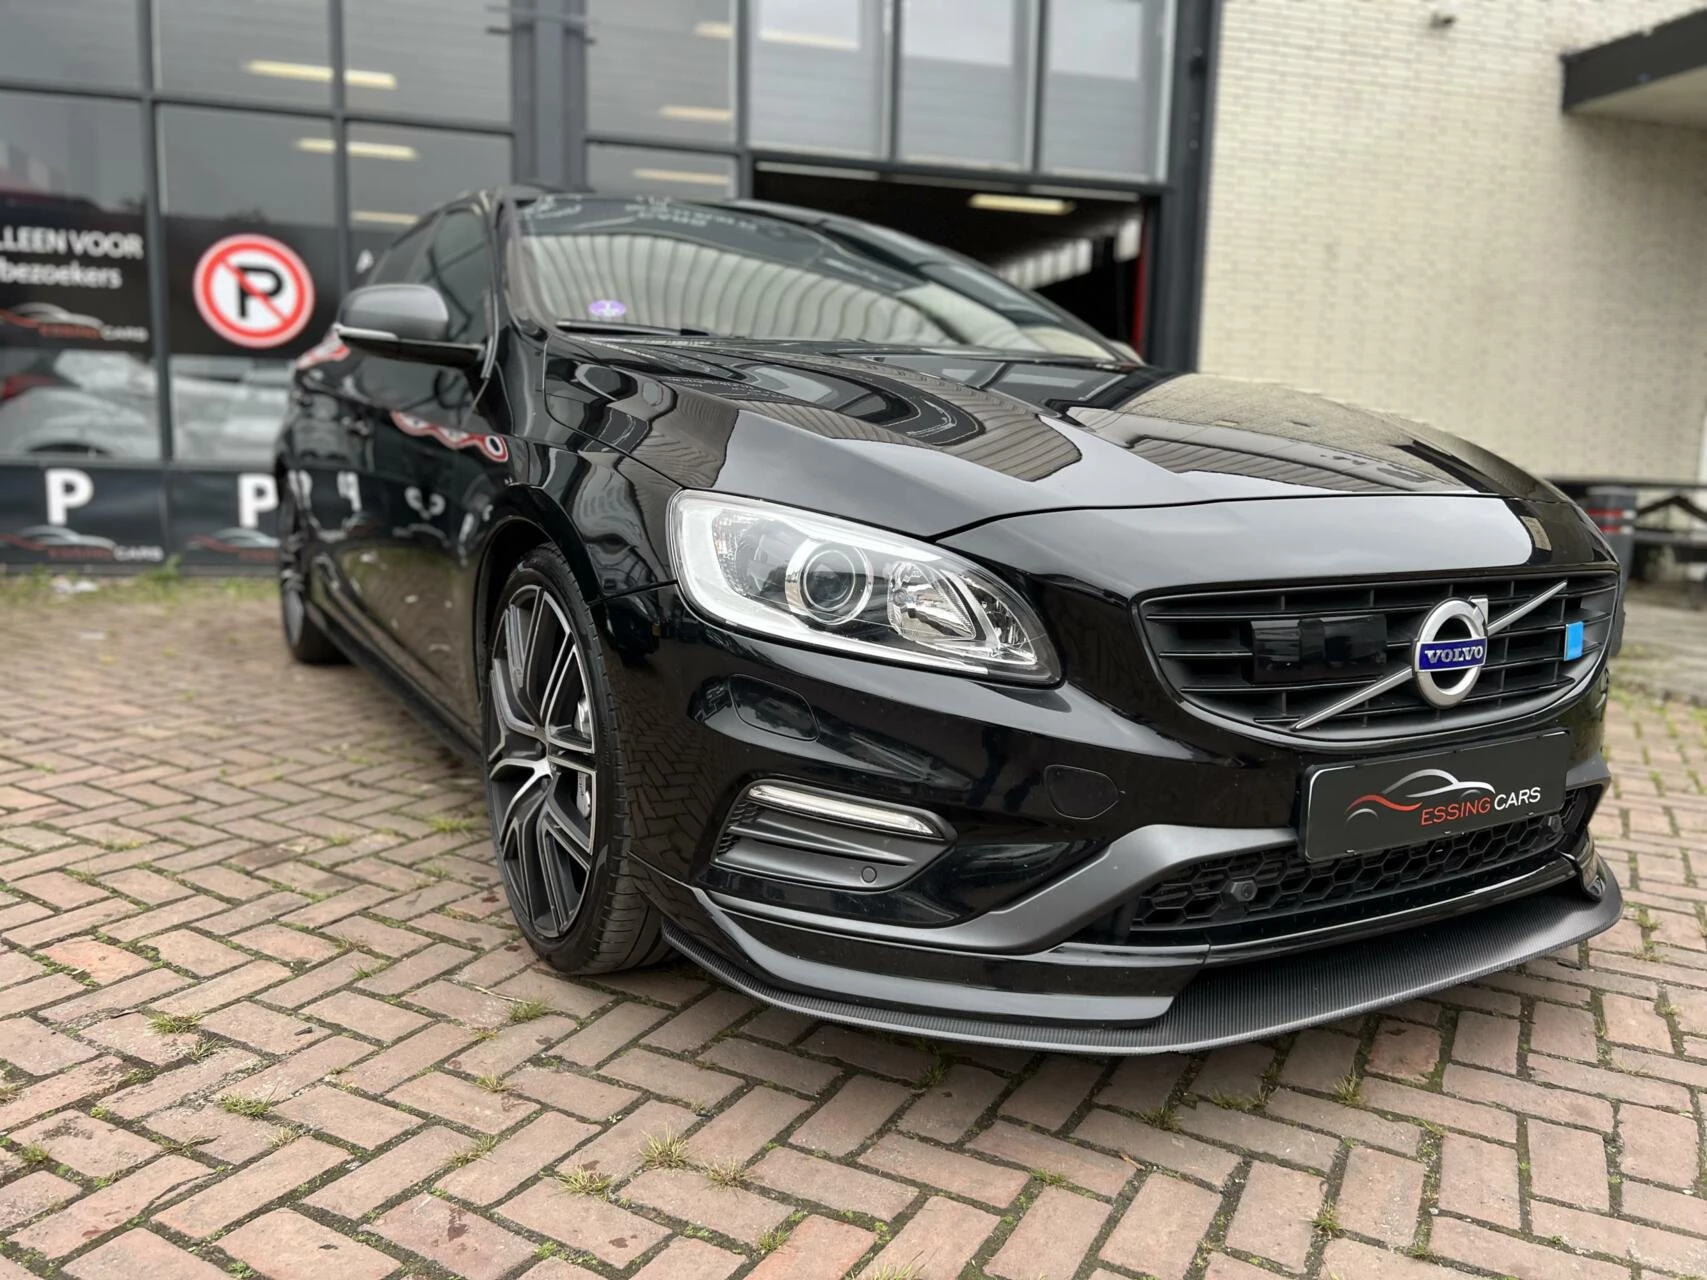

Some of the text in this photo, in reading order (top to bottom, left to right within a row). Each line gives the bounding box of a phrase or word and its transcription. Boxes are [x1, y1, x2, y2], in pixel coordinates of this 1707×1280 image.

[0, 226, 144, 259] LEEN VOOR
[45, 469, 94, 525] P
[238, 474, 279, 528] P
[1425, 646, 1483, 664] VOLVO
[1421, 787, 1541, 825] ESSING CARS
